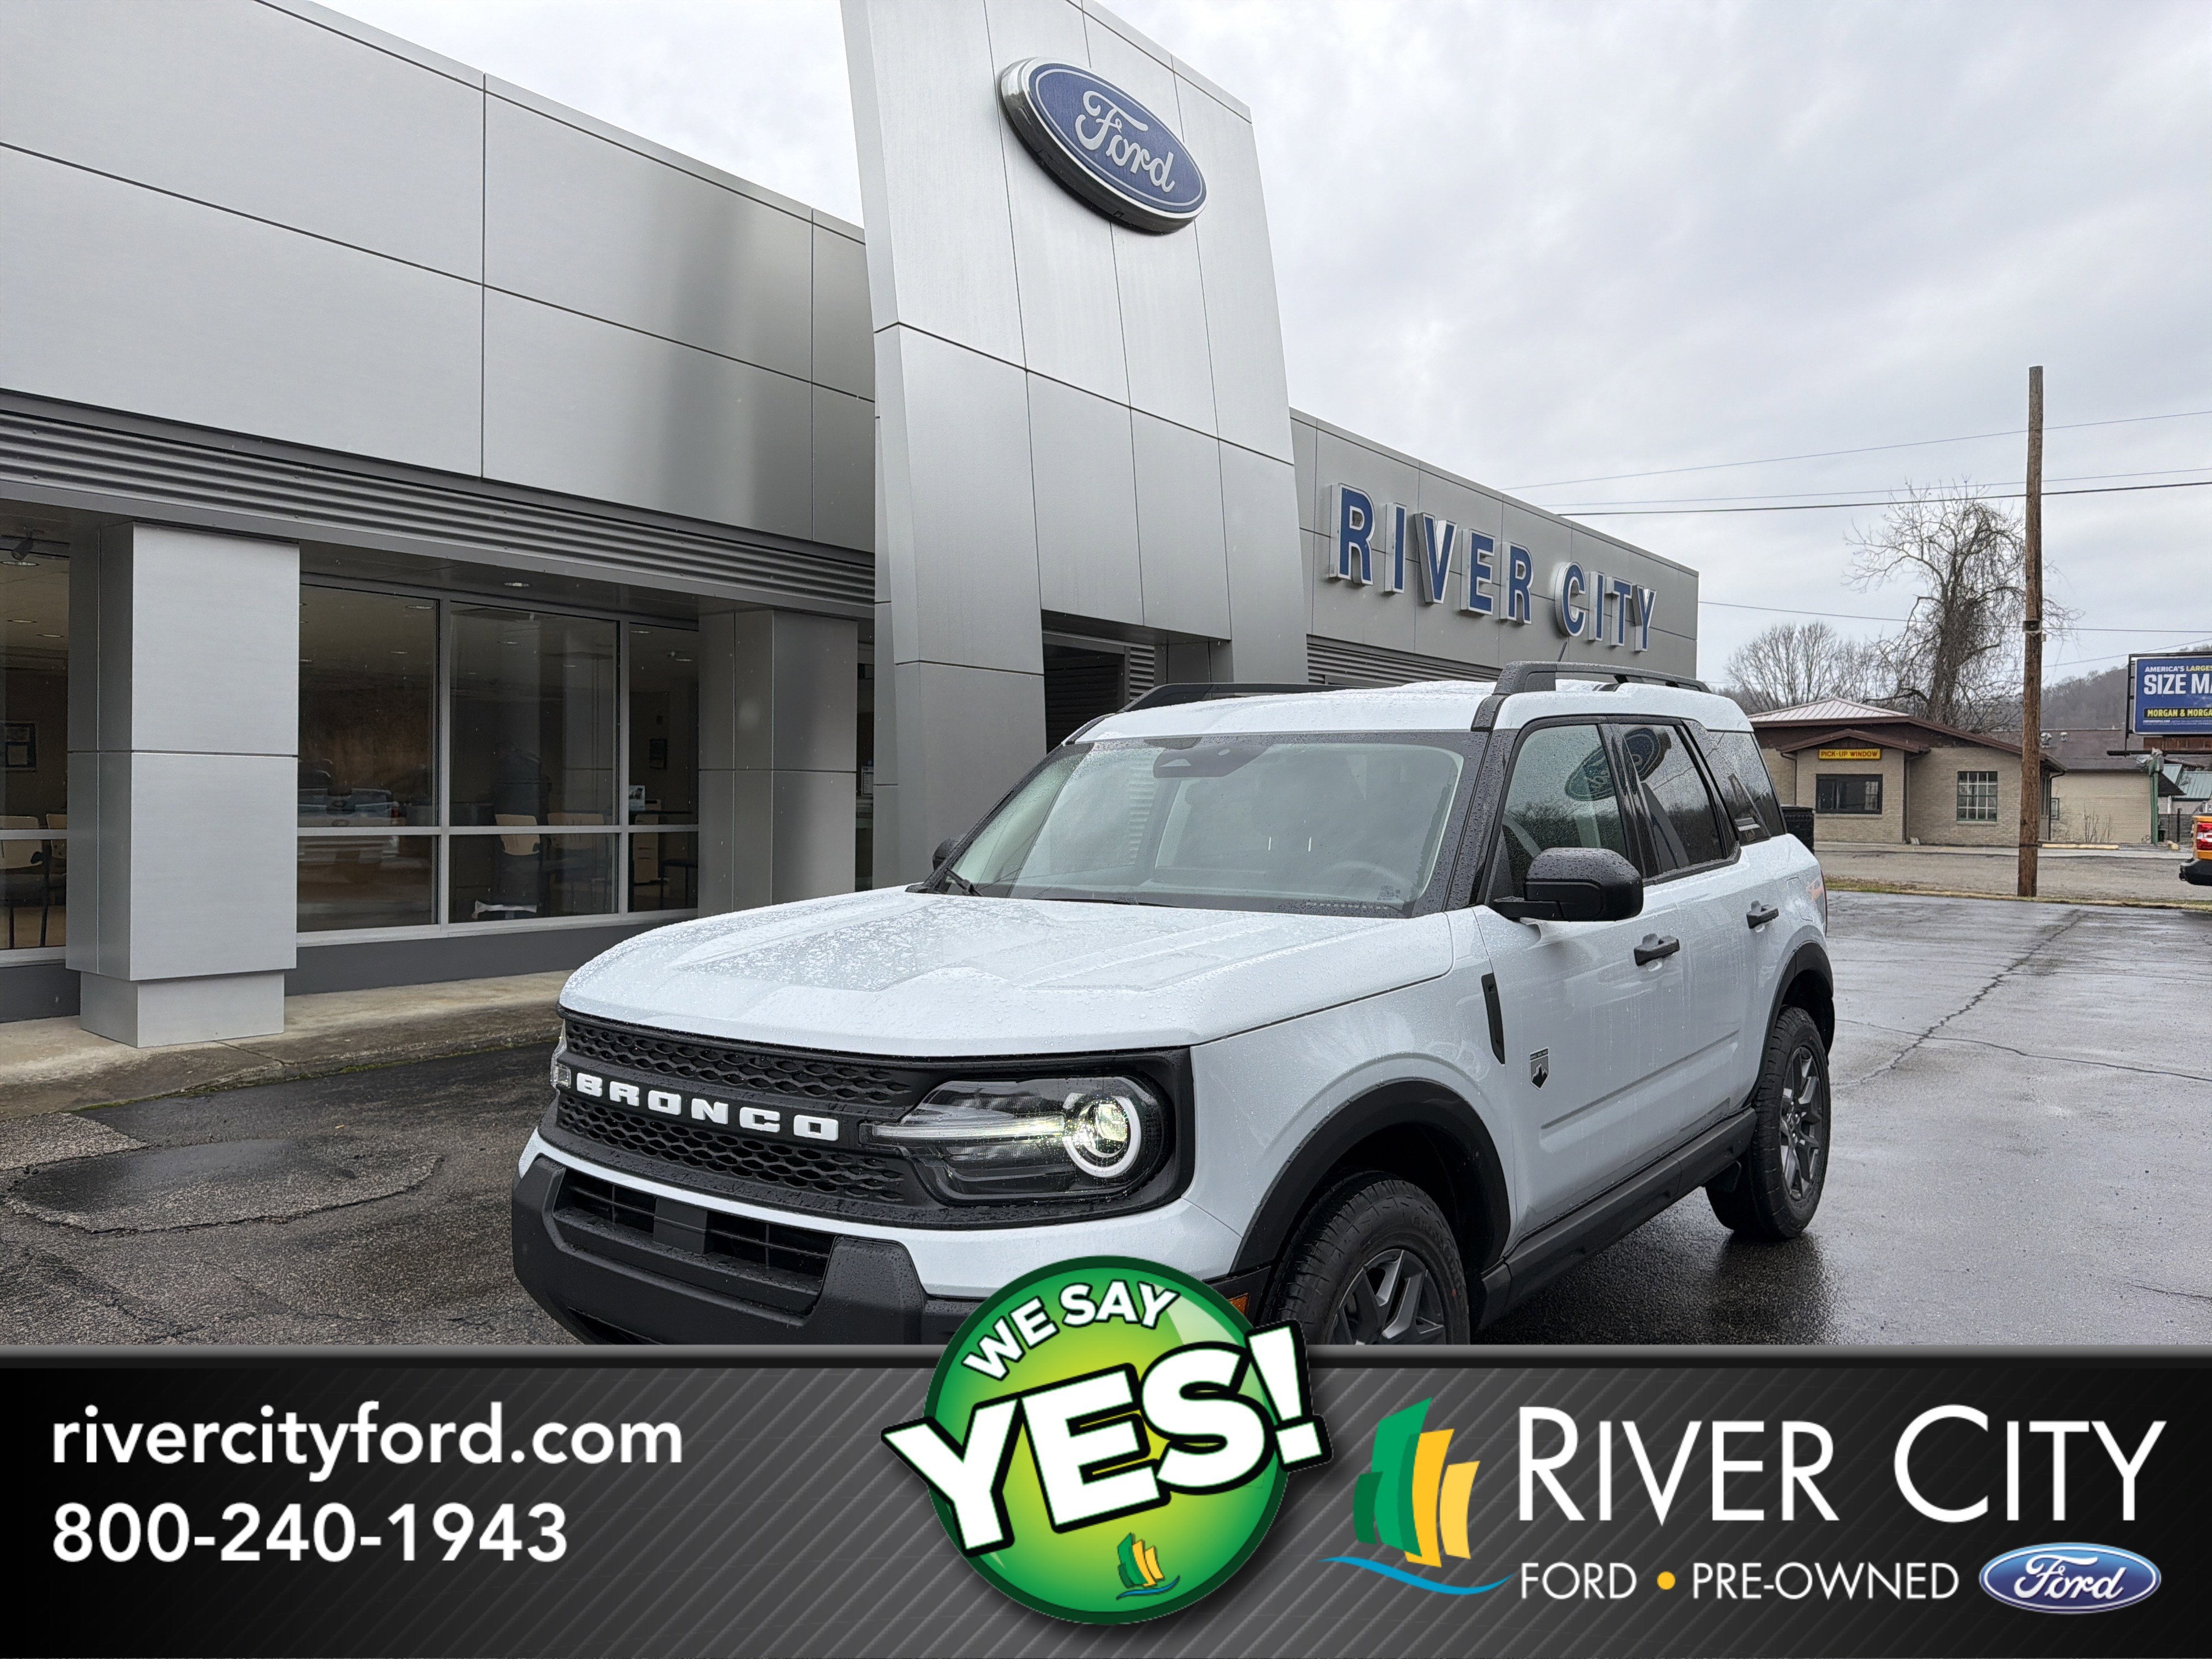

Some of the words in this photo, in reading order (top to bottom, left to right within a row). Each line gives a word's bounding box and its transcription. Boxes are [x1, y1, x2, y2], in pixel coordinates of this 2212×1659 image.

[1075, 91, 1176, 193] Ford
[1328, 483, 1534, 625] RIVER
[1555, 562, 1657, 652] CITY
[2143, 674, 2187, 695] SIZE
[2147, 709, 2178, 717] MORGAN
[2180, 709, 2186, 717] &
[577, 1073, 839, 1141] BRONCO
